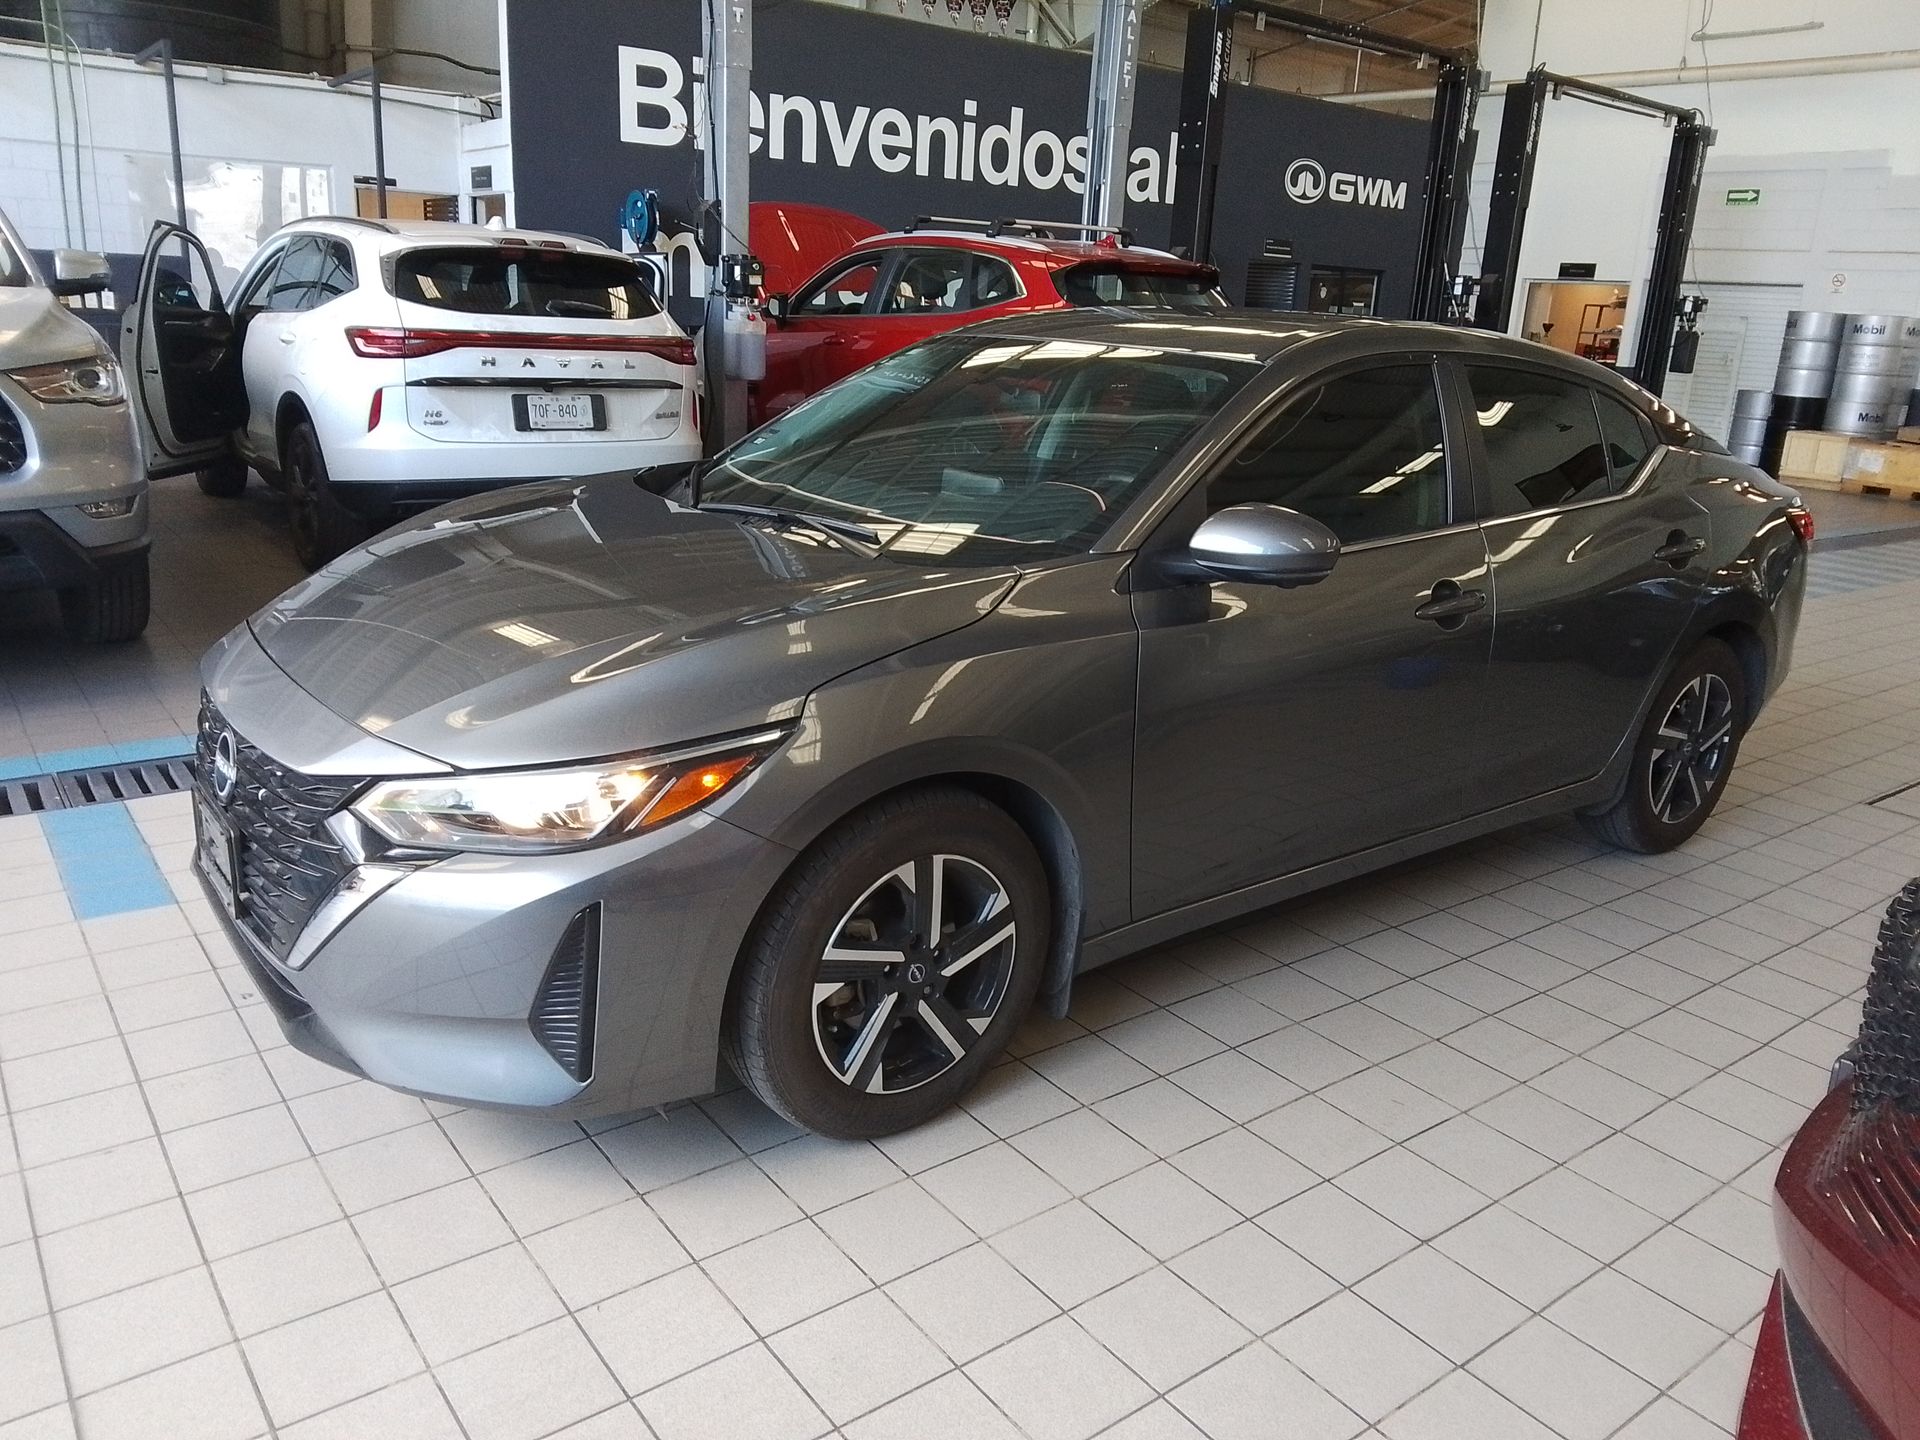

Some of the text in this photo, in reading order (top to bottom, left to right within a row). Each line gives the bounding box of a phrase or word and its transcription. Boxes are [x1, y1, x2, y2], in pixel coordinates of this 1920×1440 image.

[1210, 30, 1223, 99] Snap-on
[1222, 27, 1233, 82] RACING
[1126, 131, 1179, 205] al
[1328, 171, 1408, 210] GWM
[1852, 323, 1886, 336] Mobil
[480, 355, 637, 370] HAVAL
